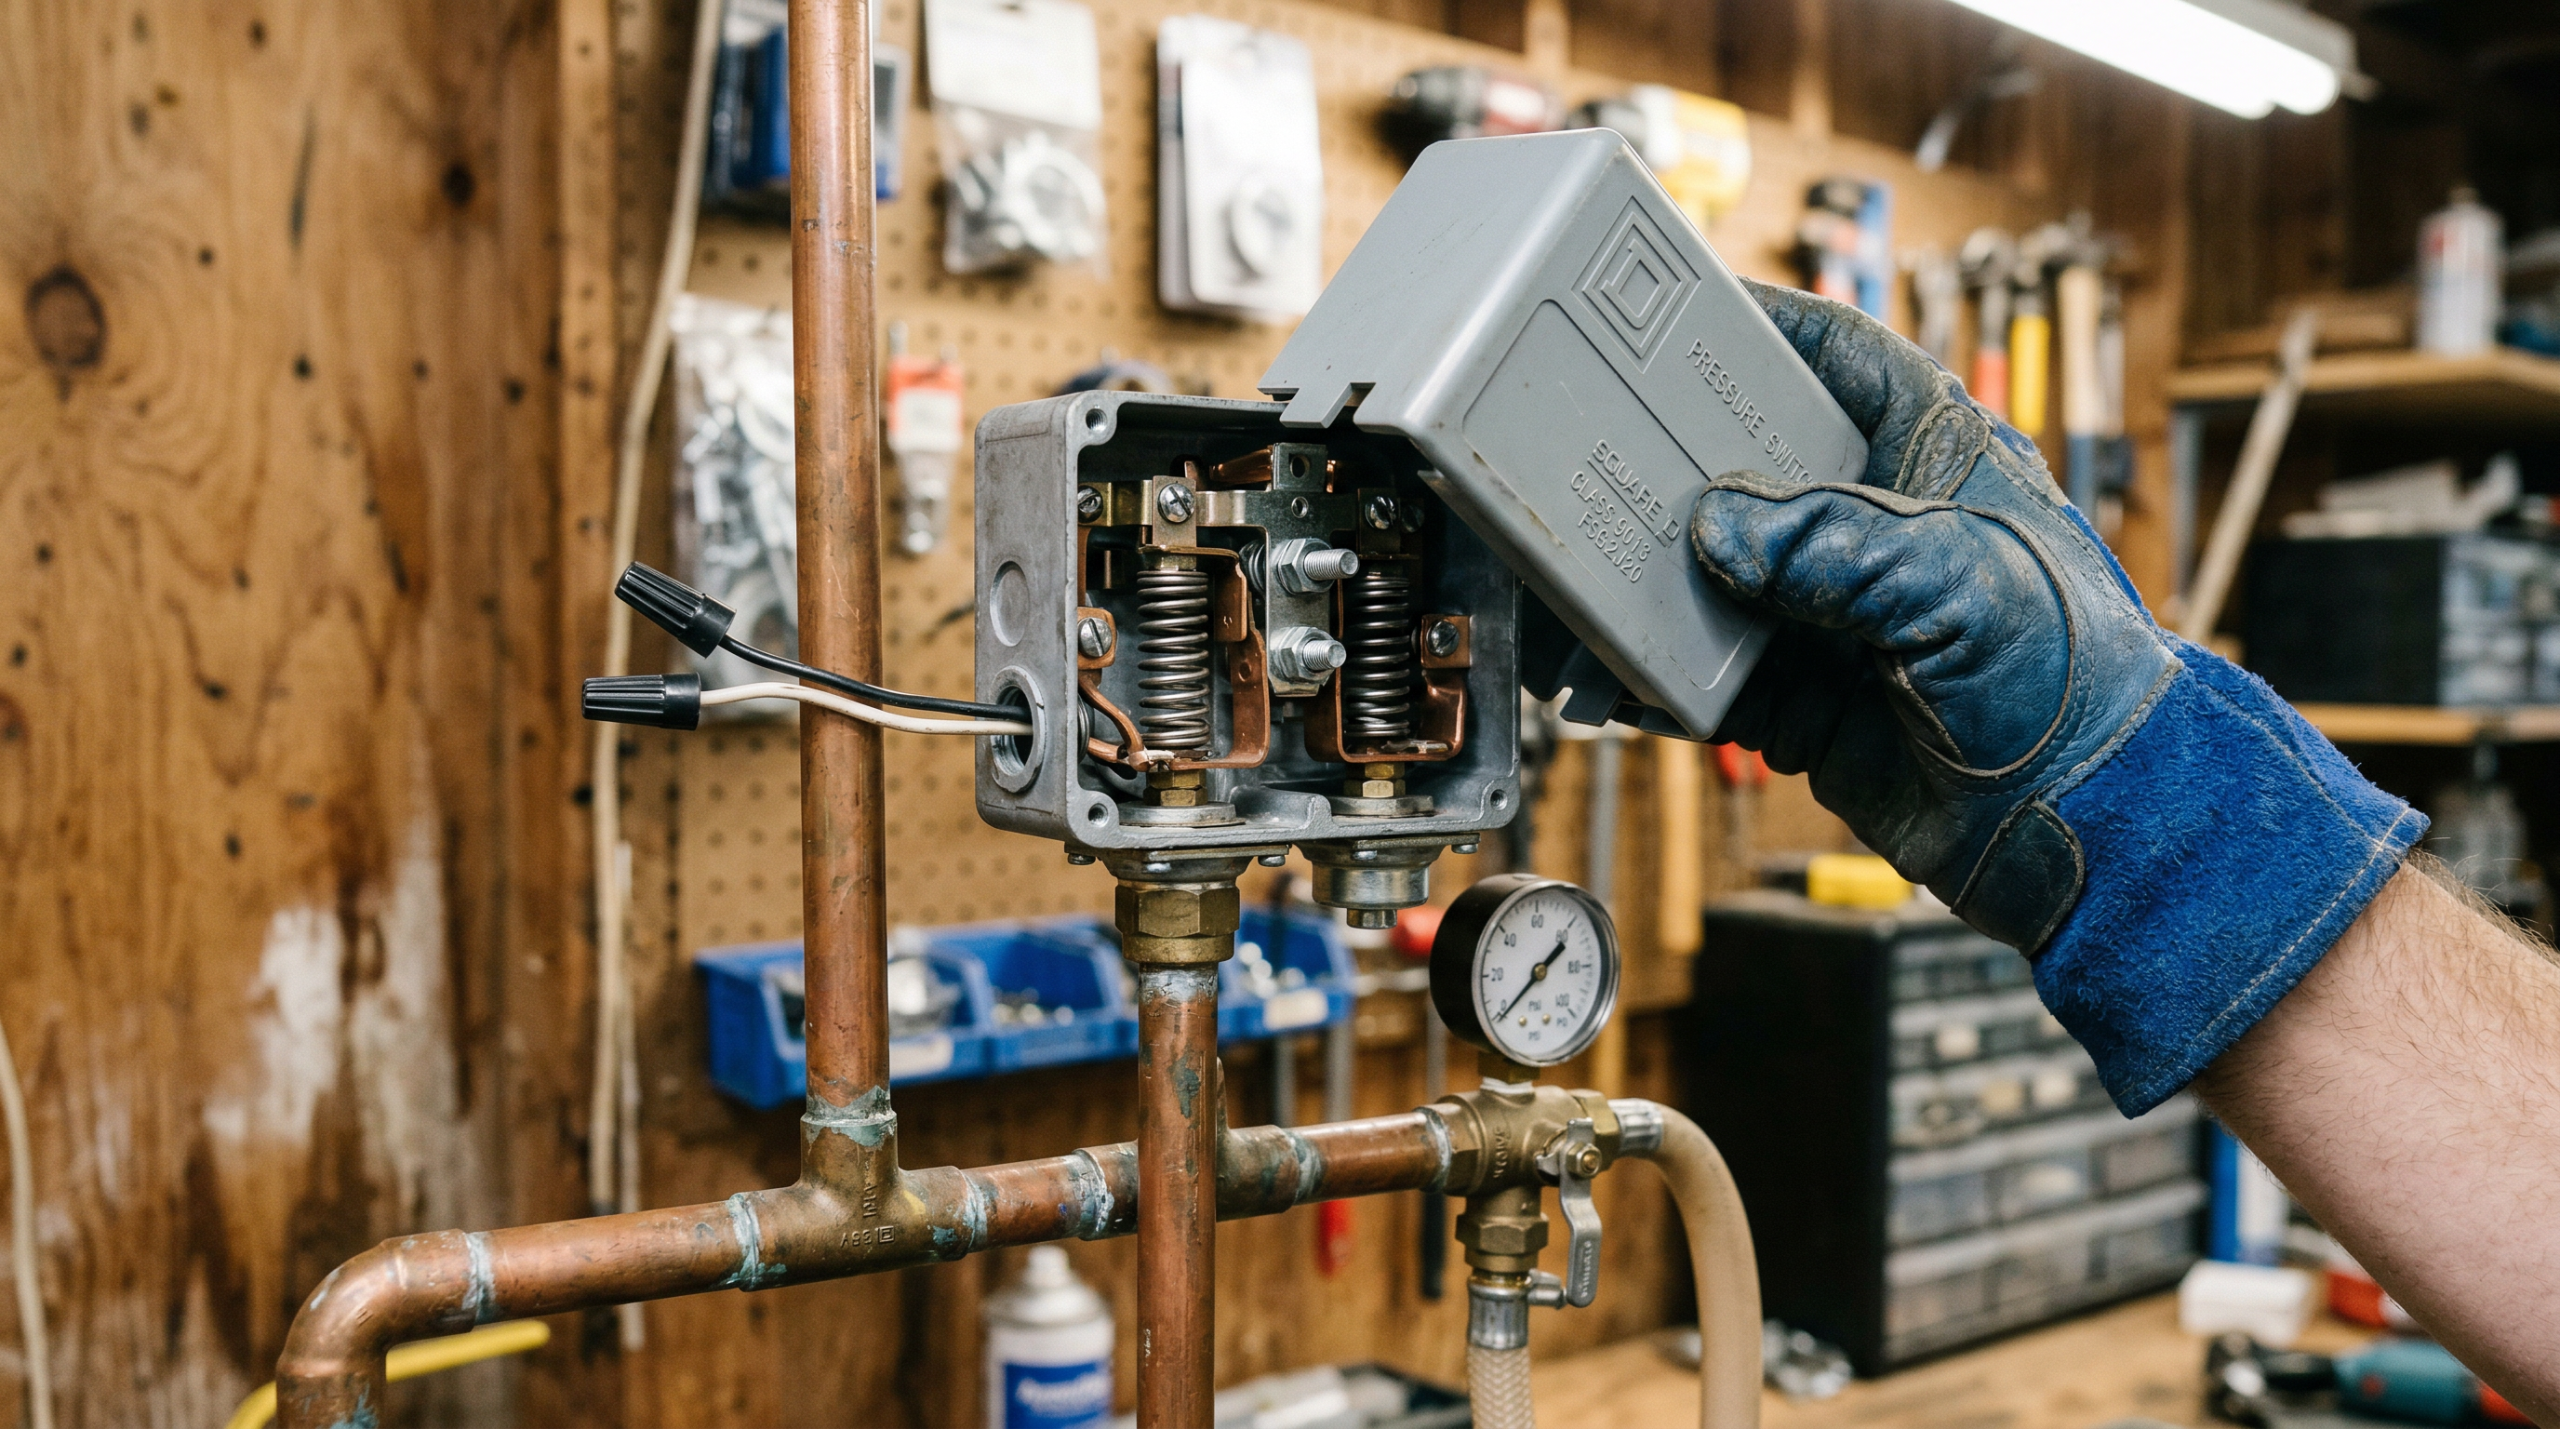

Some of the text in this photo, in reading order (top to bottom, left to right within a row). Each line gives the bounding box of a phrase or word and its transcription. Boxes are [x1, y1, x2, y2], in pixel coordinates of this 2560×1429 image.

[1686, 338, 1814, 484] PRESSURE SWITC
[1592, 439, 1681, 541] SQUARE D
[1570, 470, 1651, 562] CLASS 9013
[1577, 511, 1644, 584] FSG2J20
[1531, 914, 1544, 928] 60
[1504, 932, 1517, 947] 40
[1556, 929, 1569, 943] 80
[1491, 967, 1504, 982] 20
[1500, 999, 1507, 1011] 0
